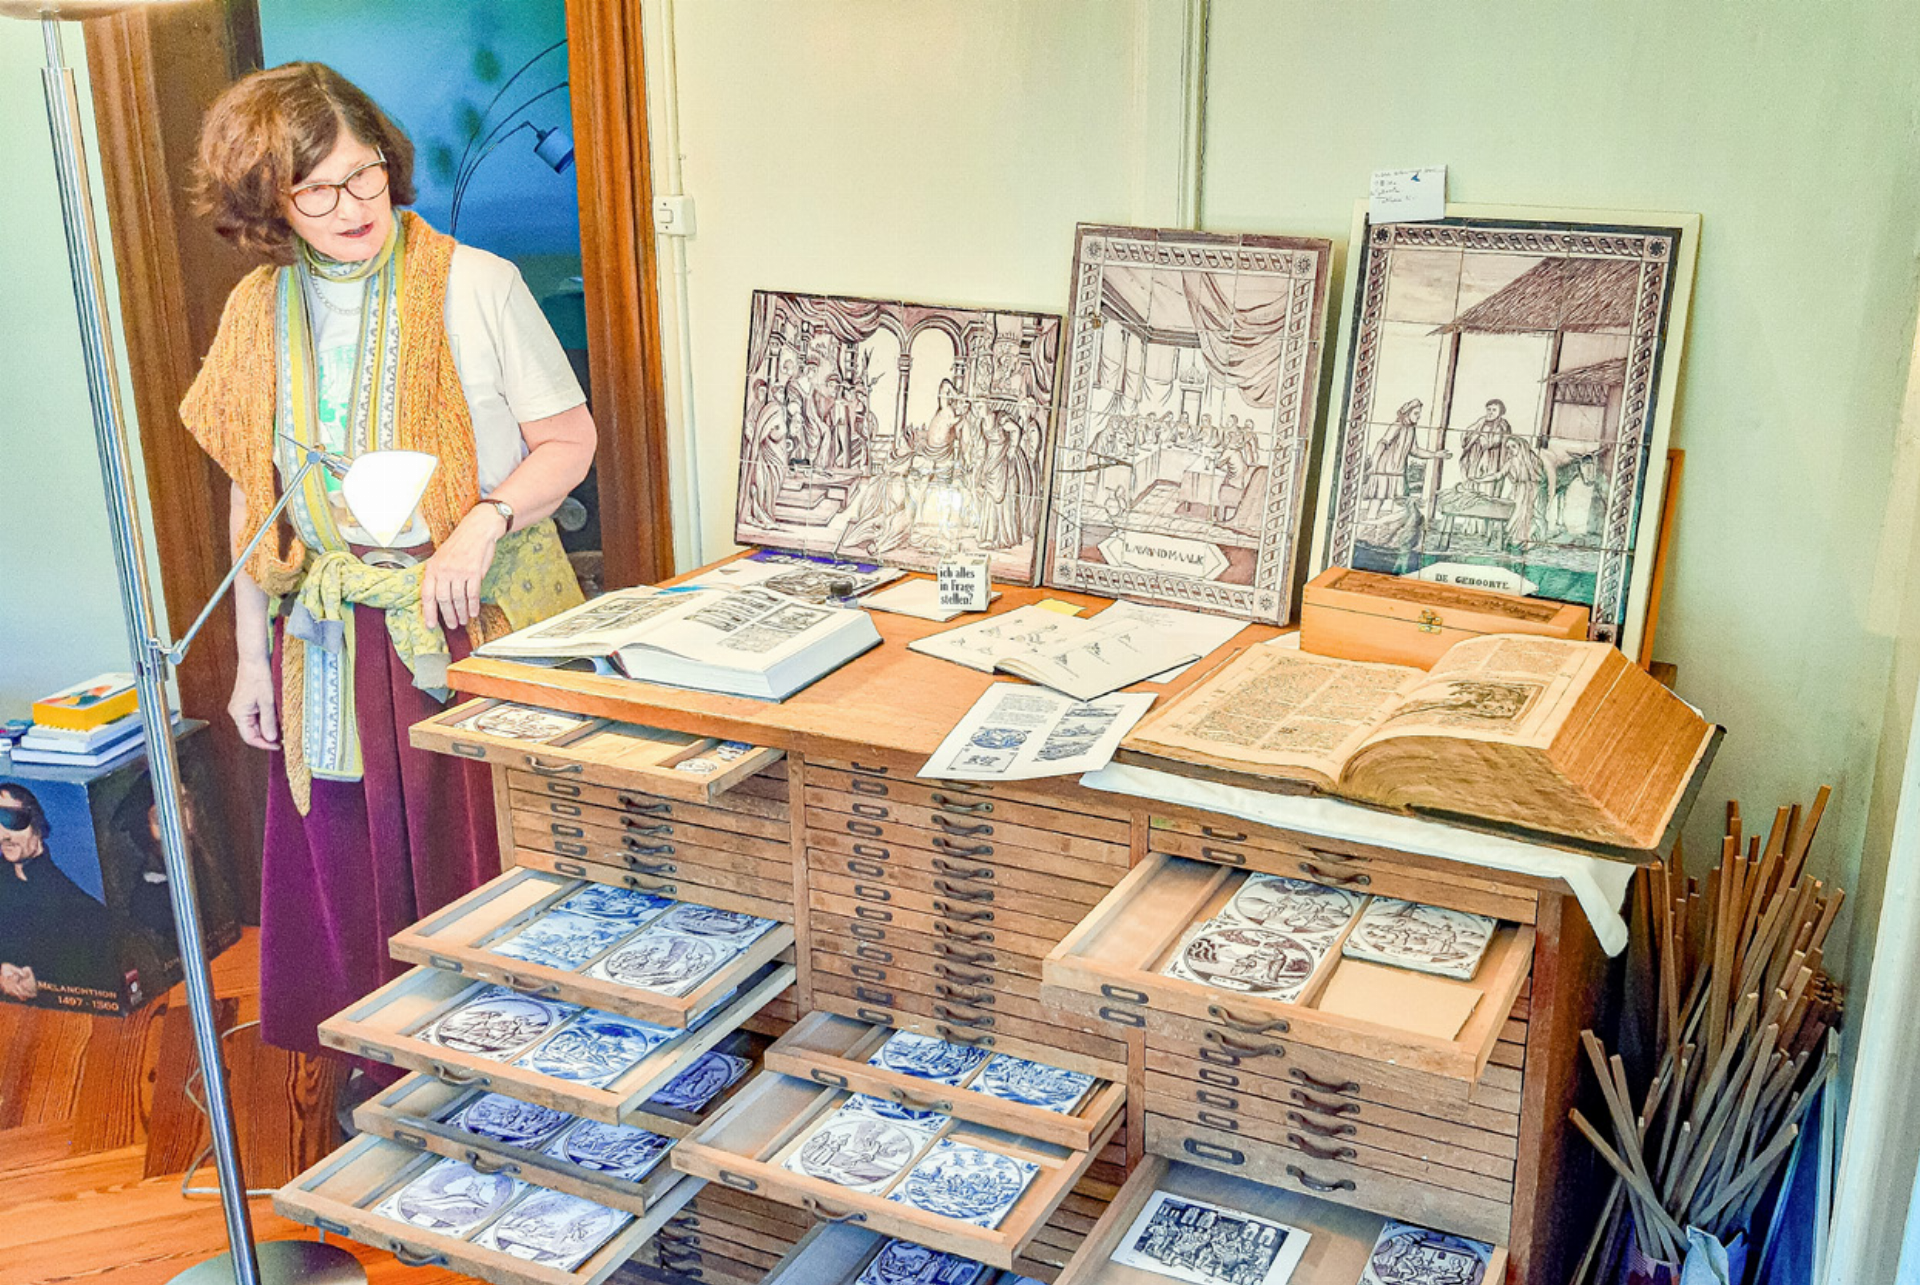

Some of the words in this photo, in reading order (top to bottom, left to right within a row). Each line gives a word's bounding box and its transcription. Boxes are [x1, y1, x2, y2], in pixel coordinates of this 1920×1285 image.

[940, 566, 953, 578] ich
[955, 566, 975, 578] alles
[1435, 573, 1448, 582] DE
[940, 579, 949, 591] in
[951, 579, 974, 594] Frage
[941, 592, 974, 605] stellen?
[58, 995, 83, 1006] 1497
